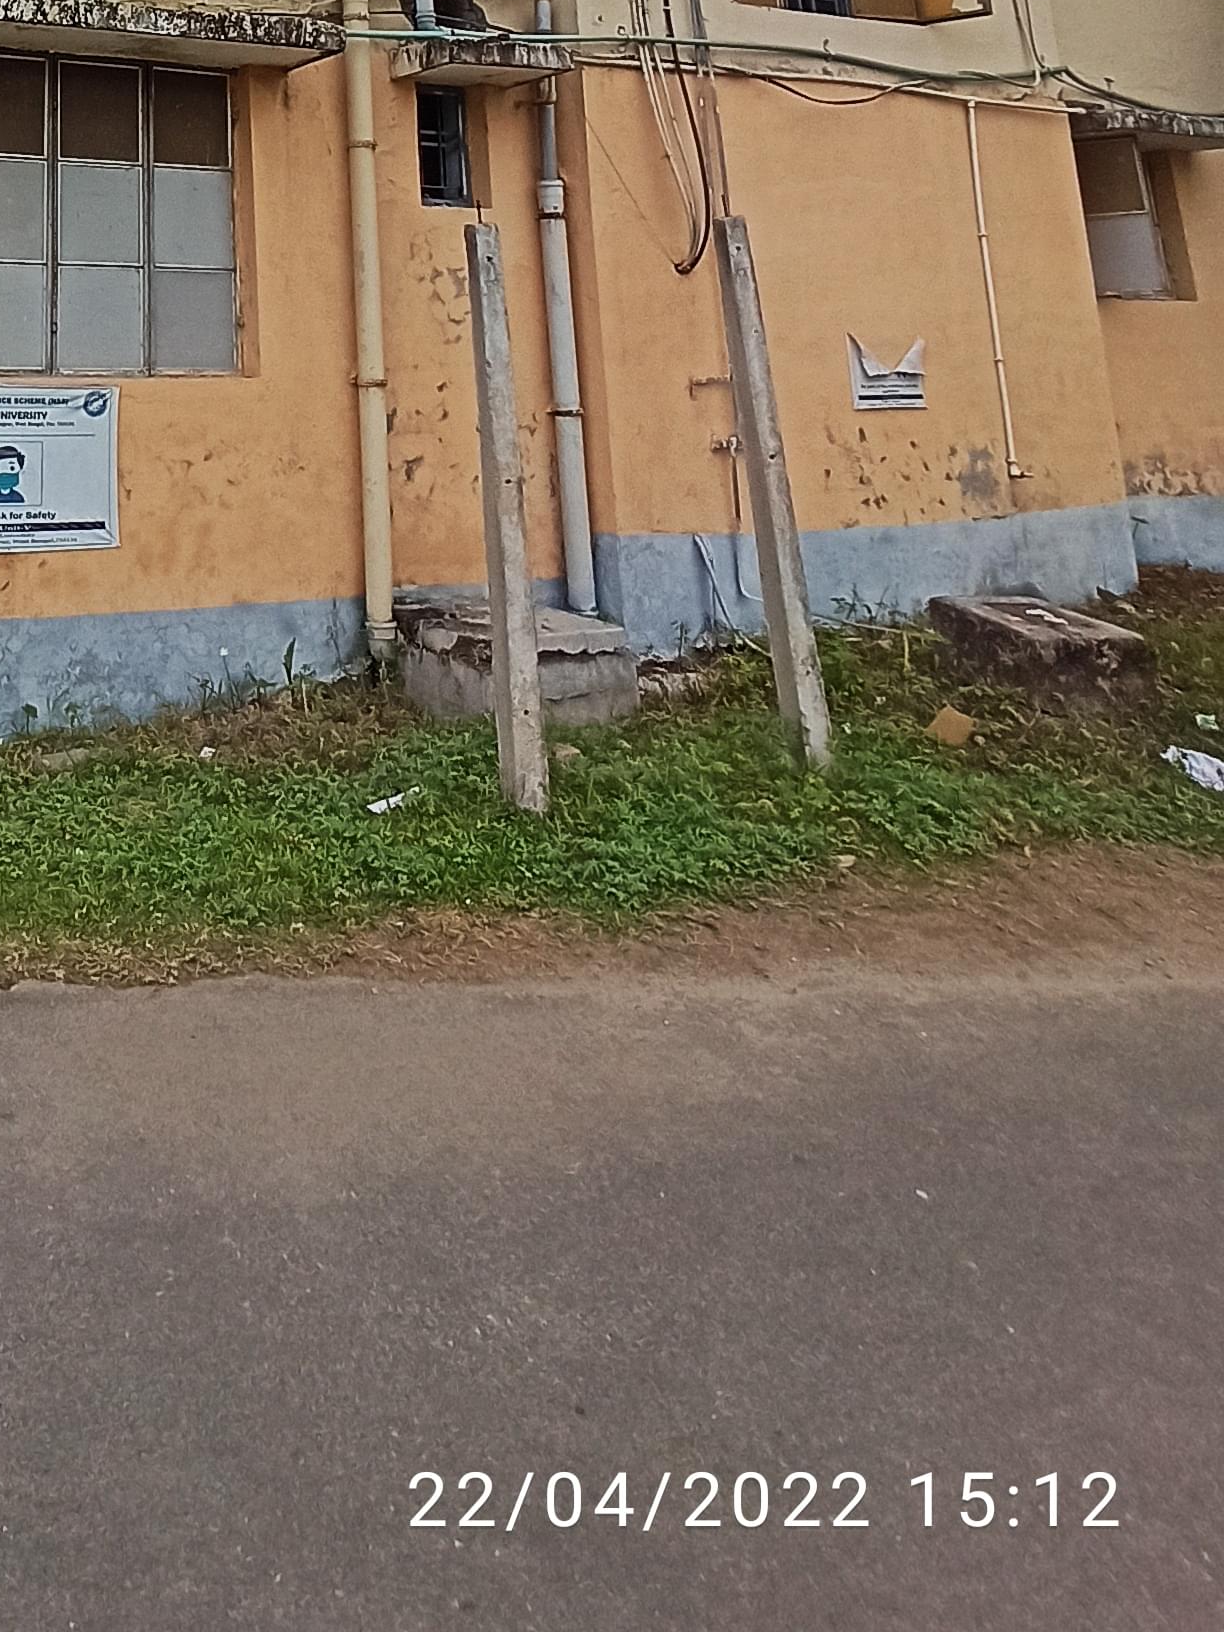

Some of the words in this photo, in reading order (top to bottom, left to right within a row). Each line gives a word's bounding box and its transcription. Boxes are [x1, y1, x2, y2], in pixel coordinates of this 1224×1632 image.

[14, 397, 47, 405] SCHEME
[9, 511, 23, 520] for
[25, 511, 57, 521] Safety
